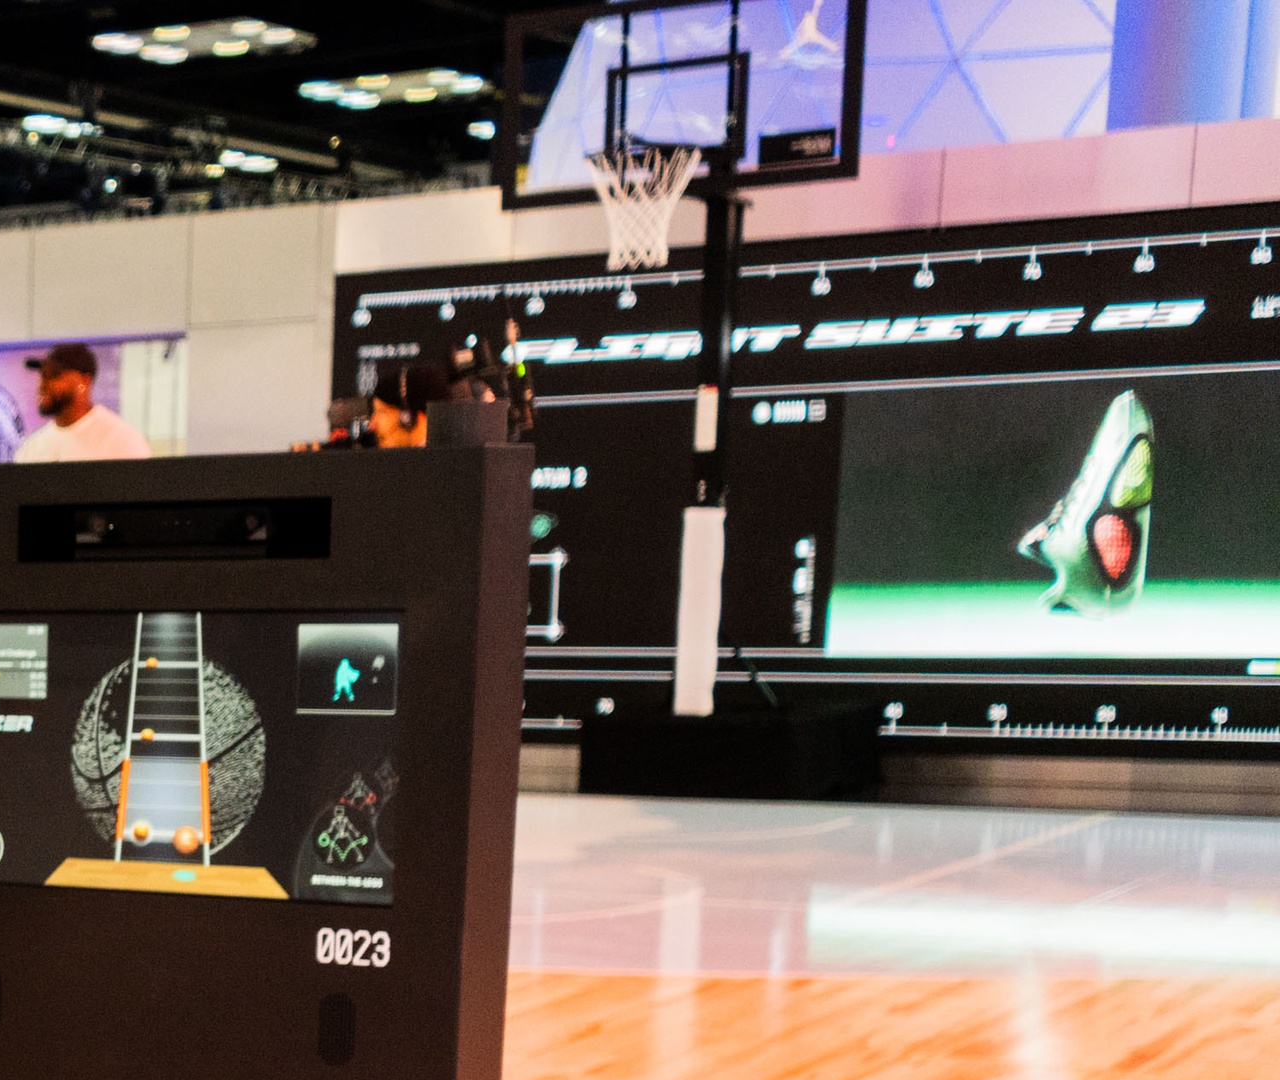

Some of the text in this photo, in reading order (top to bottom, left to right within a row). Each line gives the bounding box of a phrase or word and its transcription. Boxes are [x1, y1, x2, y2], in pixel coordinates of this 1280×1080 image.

[803, 306, 1086, 350] SUITE
[1091, 299, 1207, 332] 23
[316, 927, 391, 968] 0023
